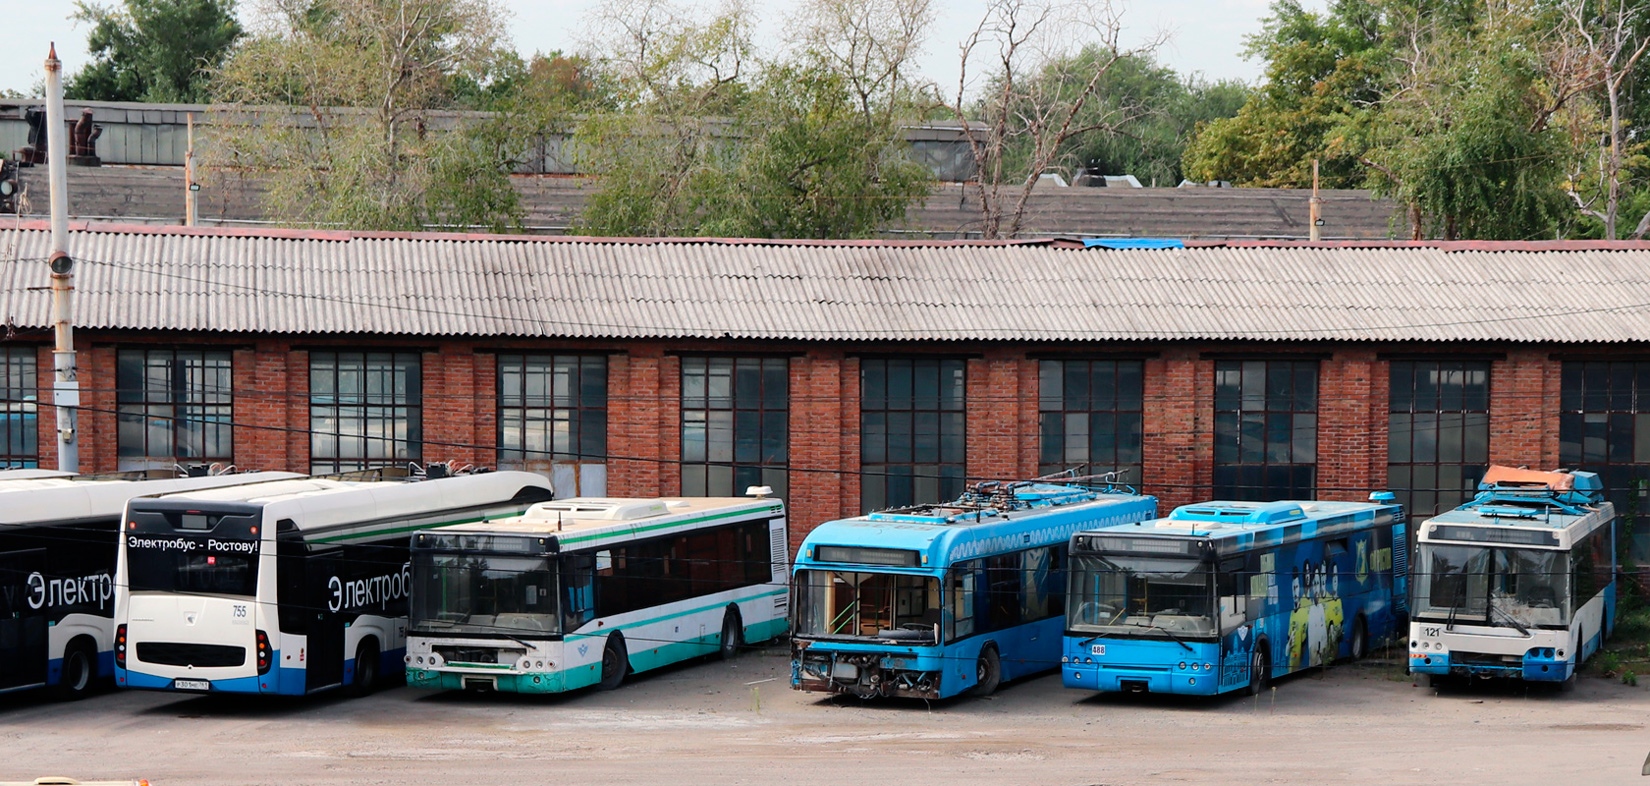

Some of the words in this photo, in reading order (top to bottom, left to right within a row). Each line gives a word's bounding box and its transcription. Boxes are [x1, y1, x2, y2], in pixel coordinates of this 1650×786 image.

[128, 536, 196, 552] Электробус
[207, 539, 258, 554] Ростову!
[27, 571, 117, 610] Электр
[233, 604, 247, 618] 755
[1425, 627, 1441, 637] 121
[1092, 645, 1105, 654] 488
